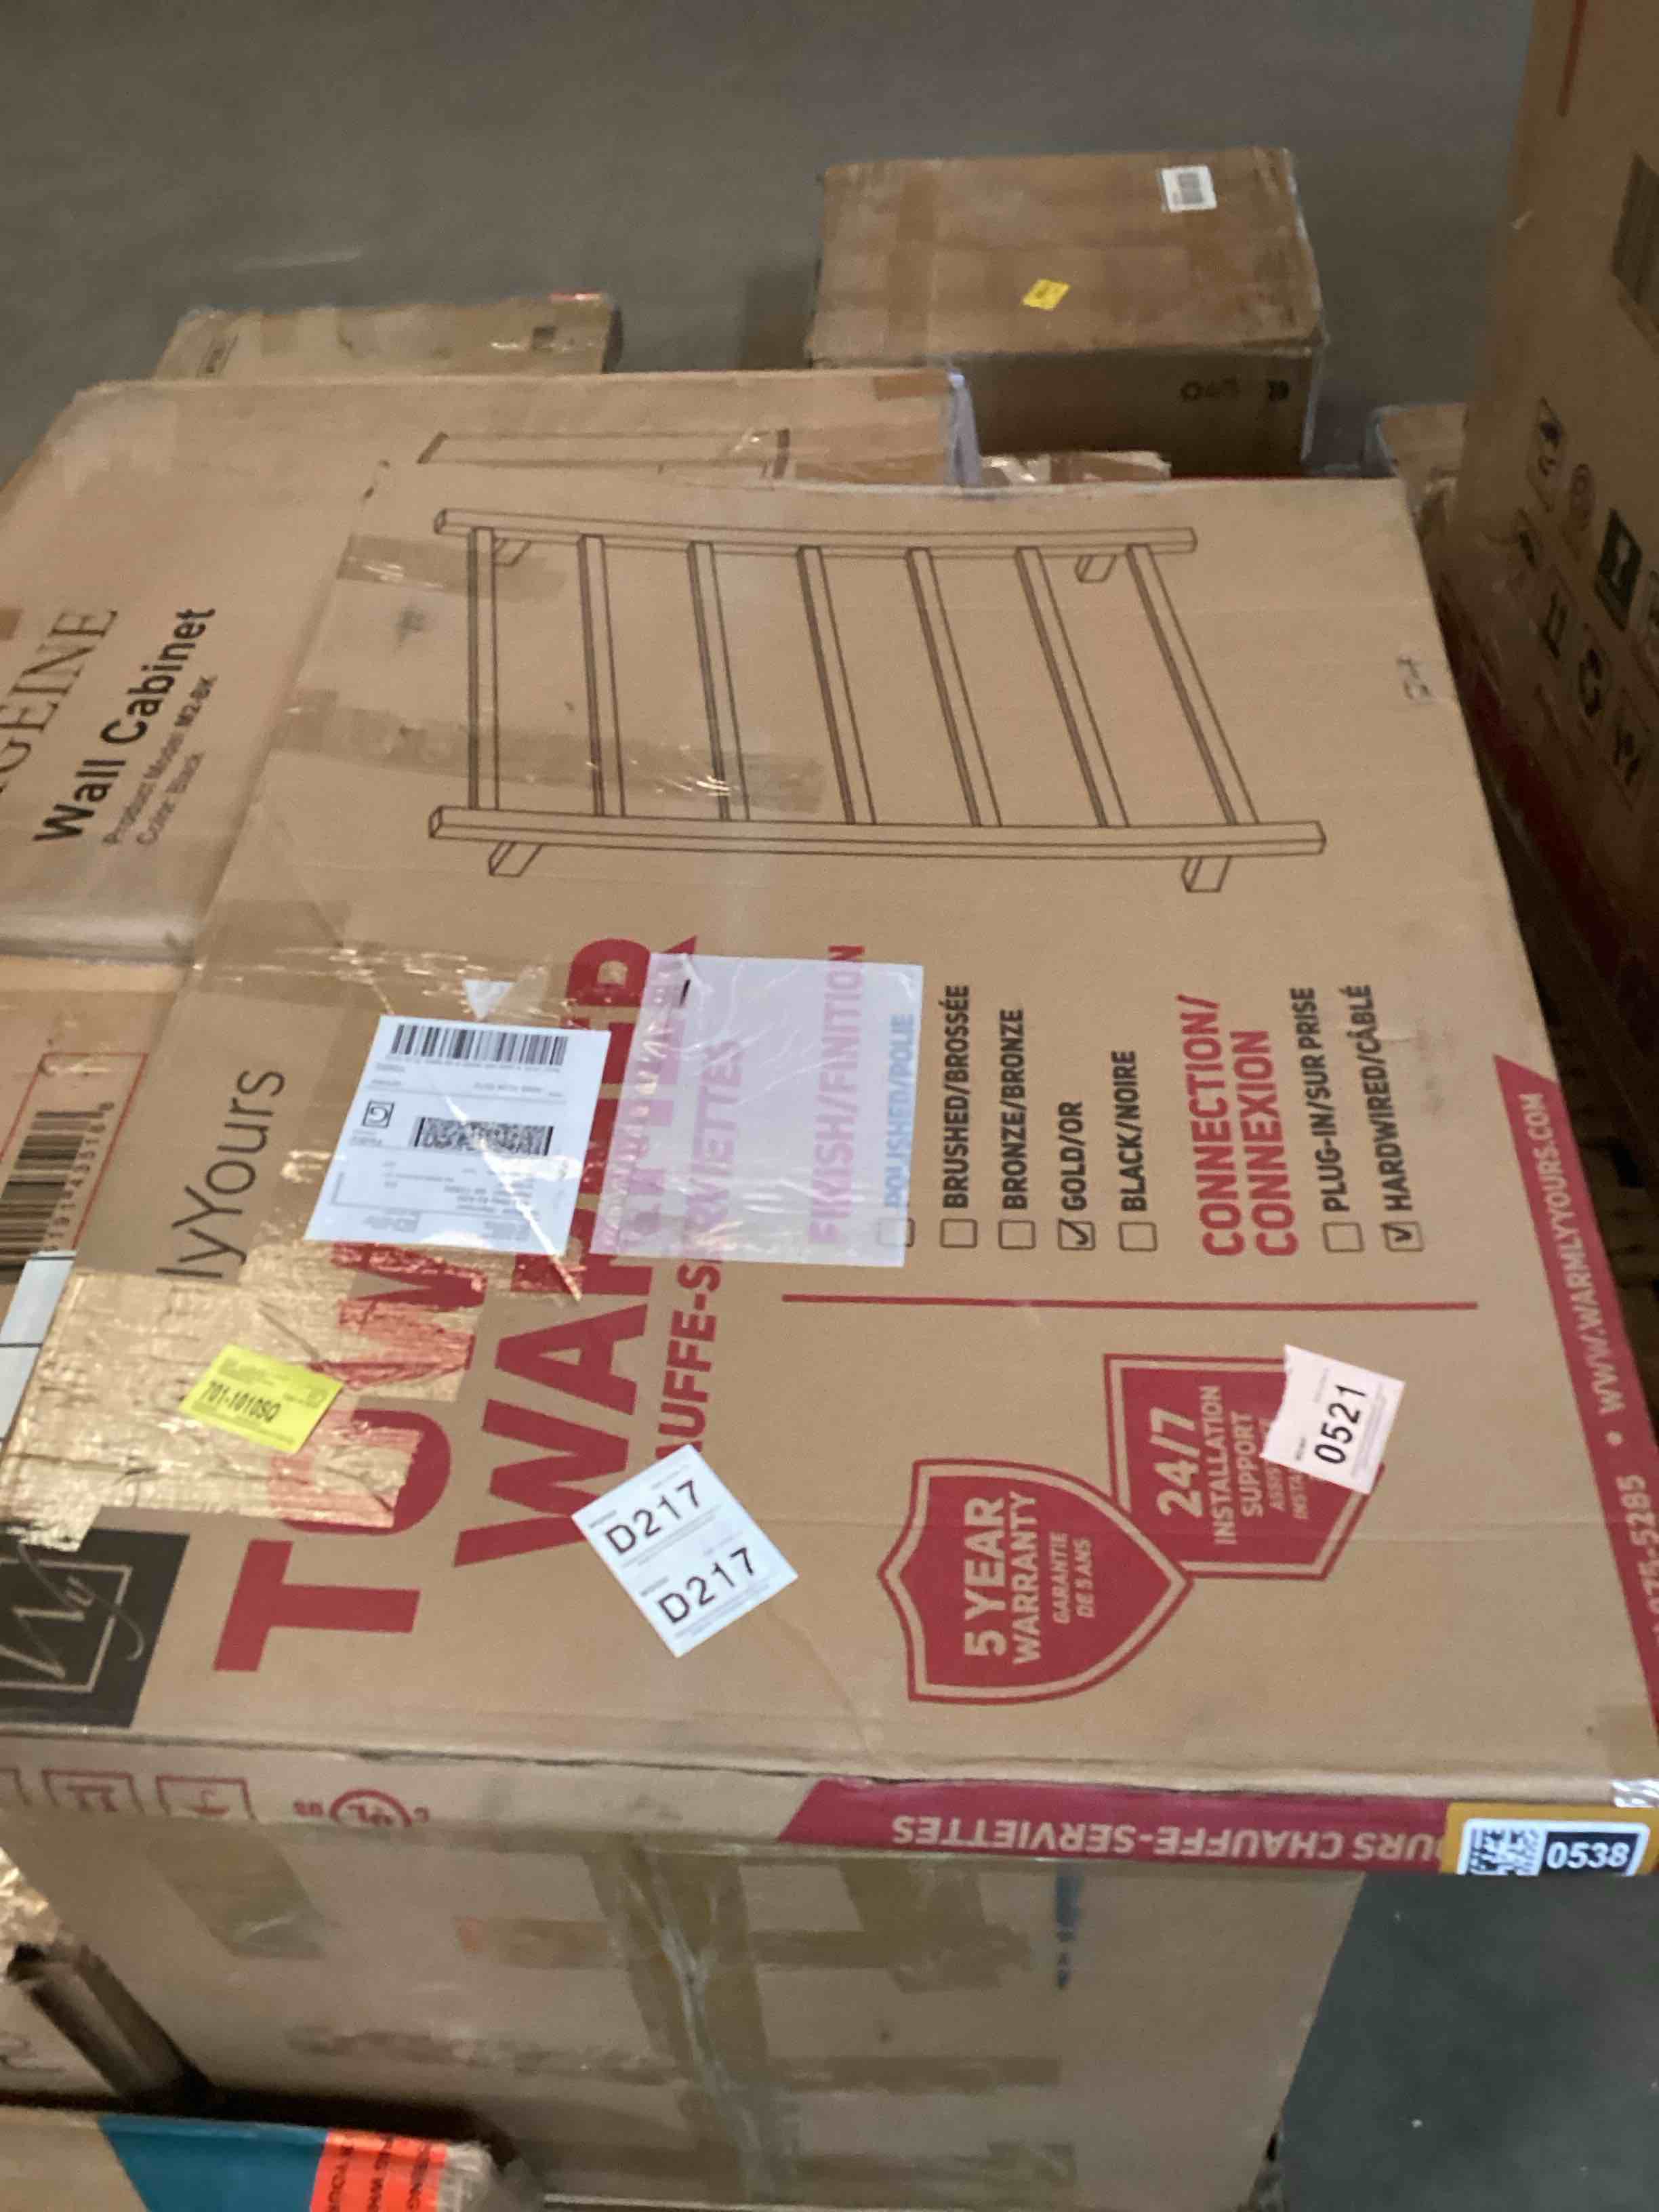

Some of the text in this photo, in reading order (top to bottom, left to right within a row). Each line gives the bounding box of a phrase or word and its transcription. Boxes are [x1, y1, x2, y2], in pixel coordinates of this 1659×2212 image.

[33, 609, 216, 842] Wall Cabinet
[157, 1069, 285, 1278] lyYours
[938, 985, 971, 1208] BRUSHED/BROSSÉE
[1000, 1009, 1027, 1210] BRONZE/BRONZE
[1058, 1101, 1087, 1211] GOLD/OR
[1111, 1050, 1147, 1212] BLACK/NOIRE
[1176, 994, 1246, 1256] CONNECTION/
[1229, 1030, 1299, 1256] CONNEXION
[1290, 987, 1349, 1212] PLUG-IN/SUR PRISE
[1519, 1093, 1626, 1416] WWW.WARMLYYOURS.COM
[1149, 1407, 1204, 1518] 24/7
[1200, 1386, 1237, 1544] INSTALLATION
[1231, 1410, 1263, 1517] SUPPORT
[1314, 1384, 1366, 1464] 0521
[605, 1480, 699, 1555] D217
[657, 1547, 754, 1623] D217
[964, 1496, 1008, 1656] 5 YEAR
[1008, 1491, 1041, 1664] WARRANTY
[1050, 1530, 1070, 1624] GARANTIE
[892, 1816, 1344, 1860] CHAUFFE-SERVIETTES
[1547, 1841, 1630, 1869] 0538
